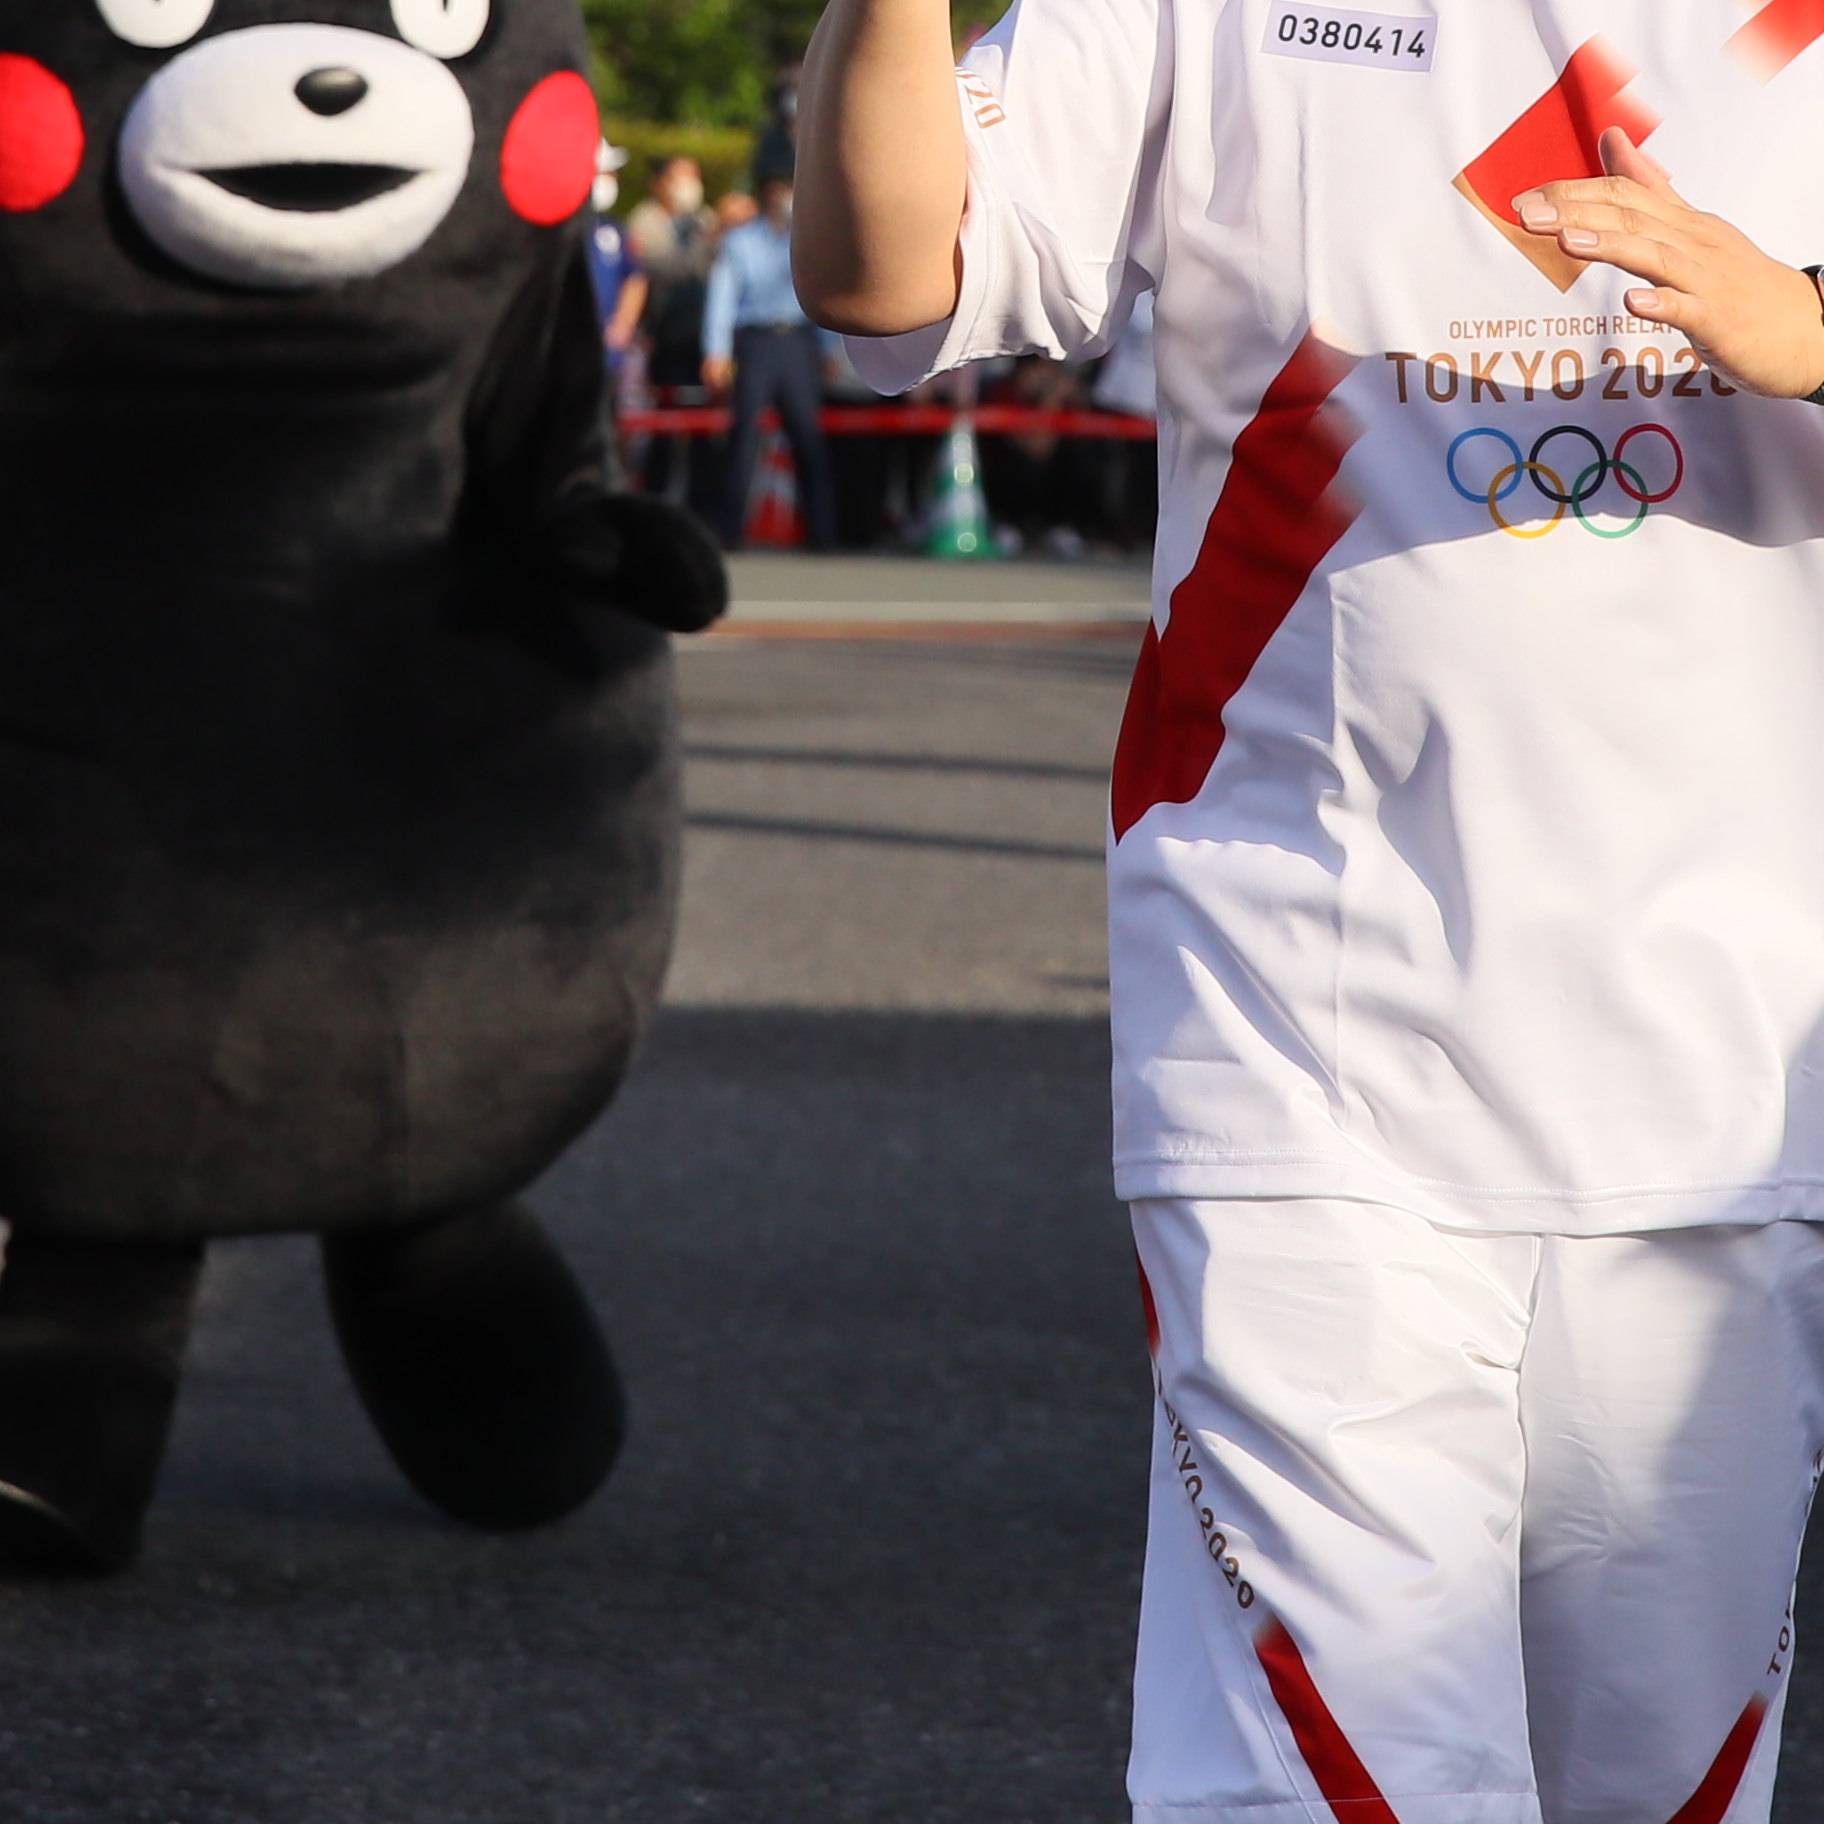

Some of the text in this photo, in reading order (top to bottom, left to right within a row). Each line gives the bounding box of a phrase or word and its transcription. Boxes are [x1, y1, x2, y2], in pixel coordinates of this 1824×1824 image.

[1278, 14, 1426, 58] 0380414
[1448, 314, 1673, 340] OLYMPIC TORCH RELA
[1385, 348, 1585, 404] TOKYO
